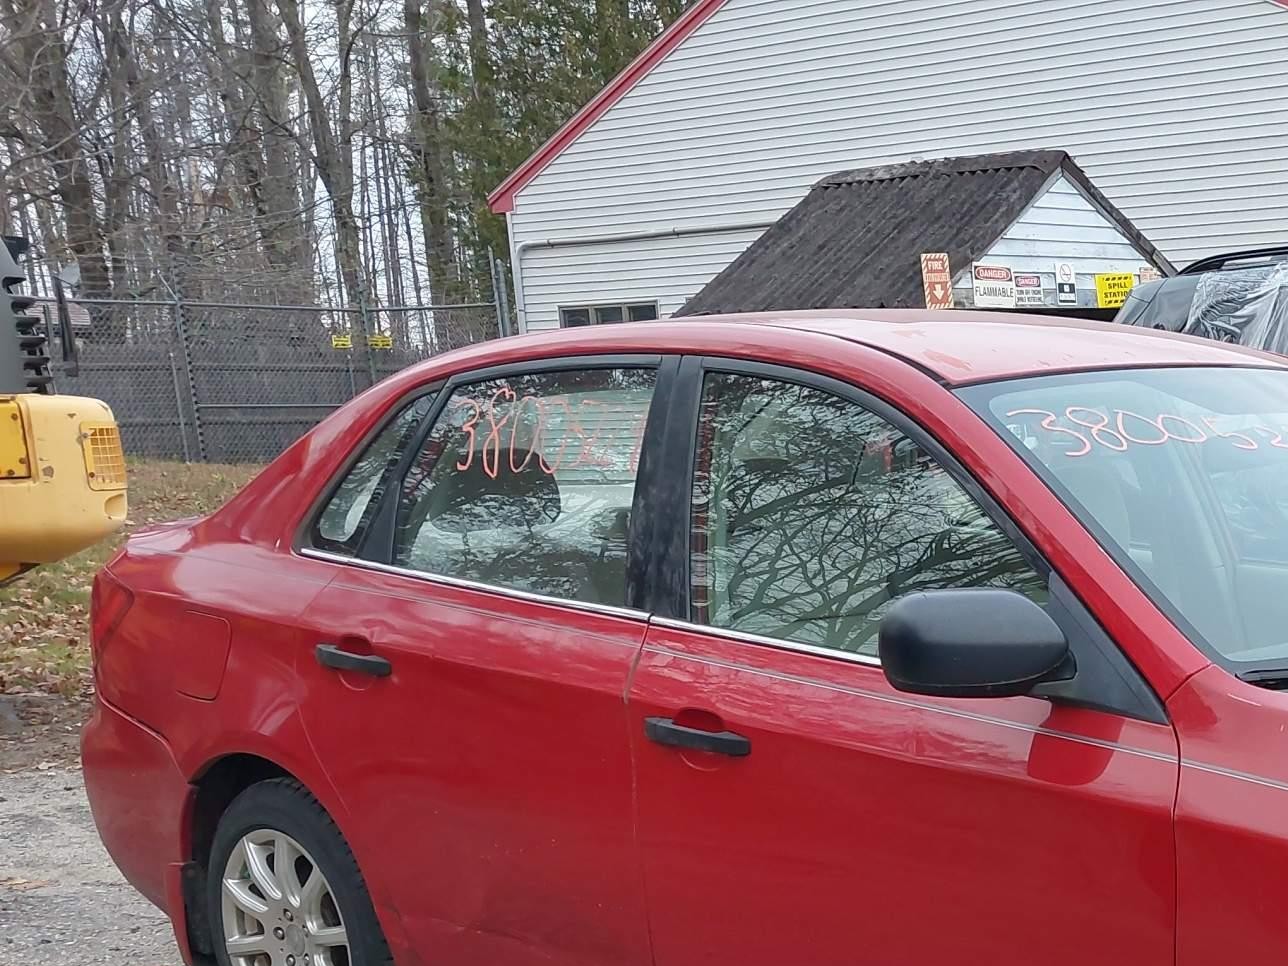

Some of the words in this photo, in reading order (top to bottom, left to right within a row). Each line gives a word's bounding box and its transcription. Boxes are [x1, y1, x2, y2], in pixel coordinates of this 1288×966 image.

[927, 260, 944, 271] FIRE
[979, 269, 1008, 279] DANGER
[1107, 282, 1129, 290] SPILL
[975, 286, 1014, 298] FLAMMABLE
[1103, 291, 1129, 299] STATIO
